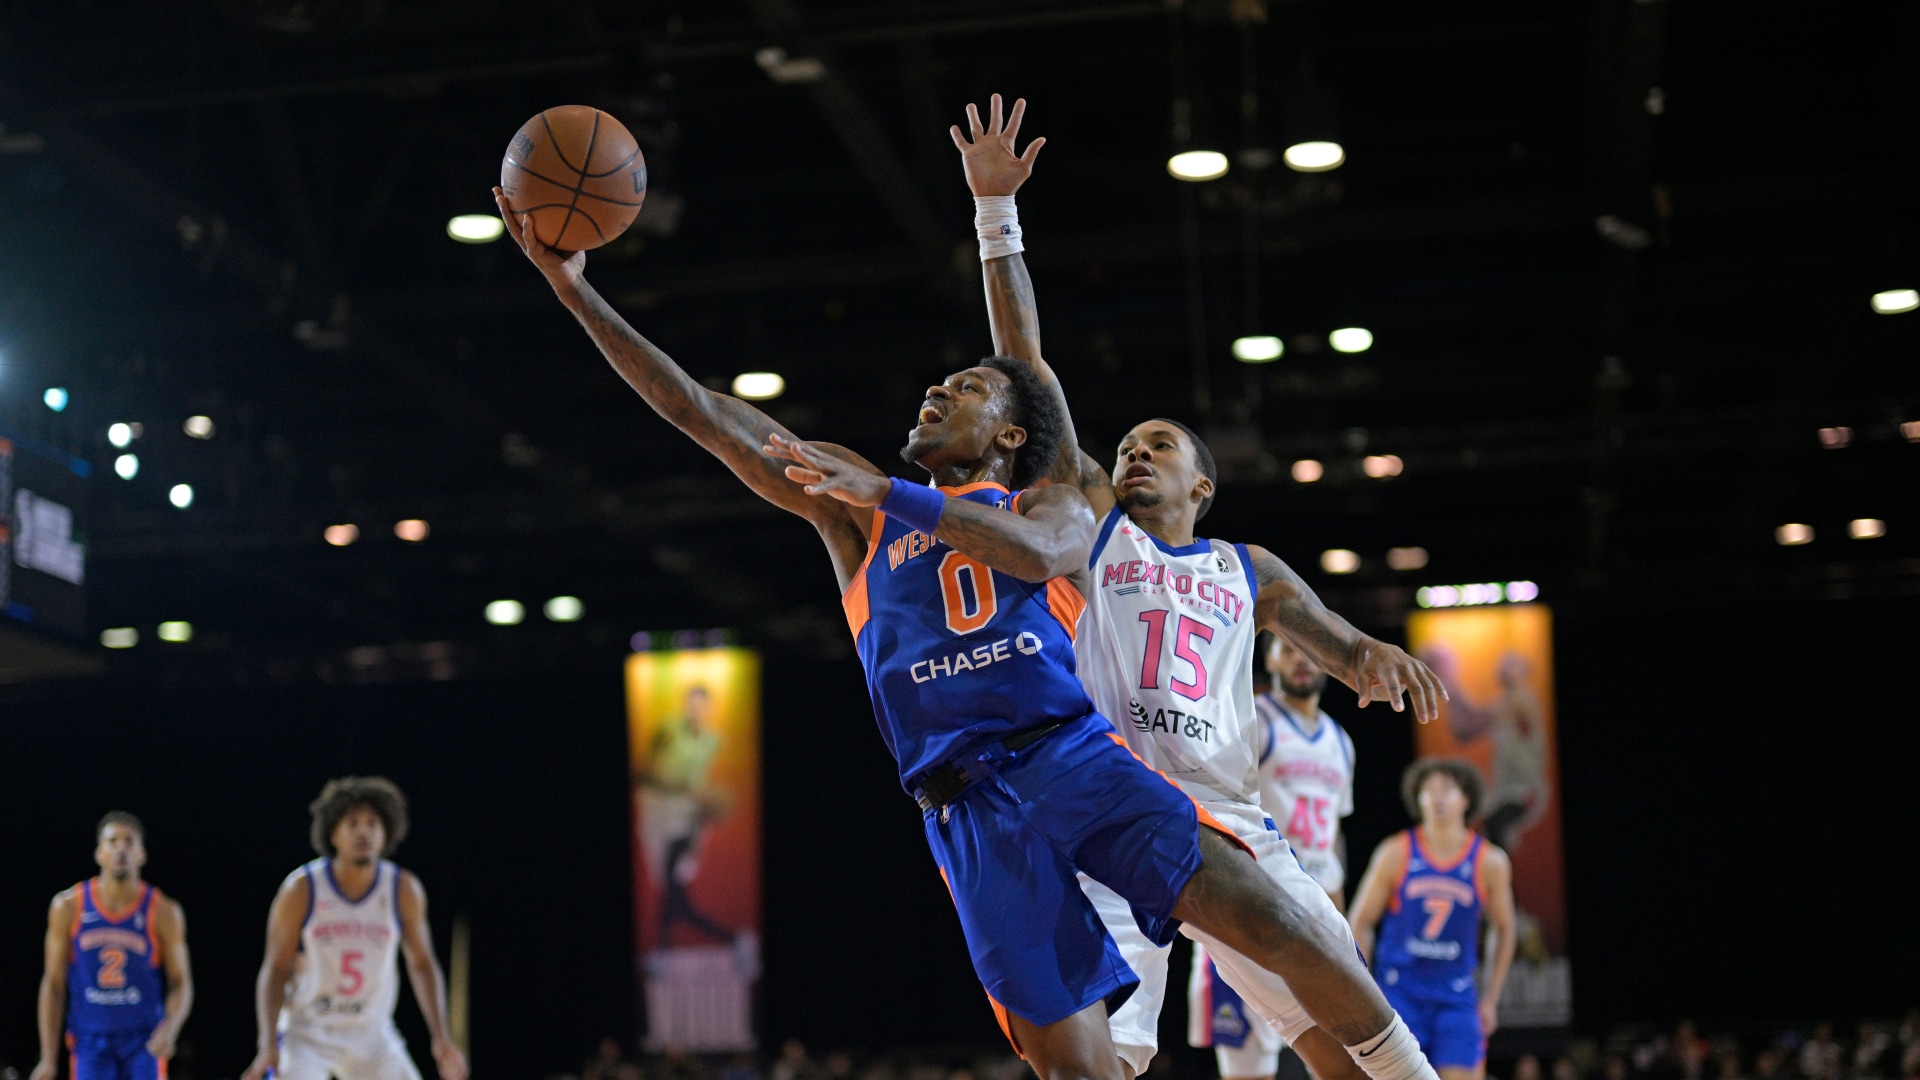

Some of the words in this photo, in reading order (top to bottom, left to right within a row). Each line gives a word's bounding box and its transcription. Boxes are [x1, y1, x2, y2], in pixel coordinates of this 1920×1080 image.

[938, 550, 997, 635] 0
[1102, 560, 1192, 595] MEXICO
[1198, 581, 1244, 623] CITY
[910, 638, 1012, 684] CHASE
[1138, 609, 1215, 702] 15
[1152, 708, 1214, 743] AT&T
[1286, 796, 1330, 850] 45
[1423, 897, 1454, 939] 7
[99, 948, 126, 987] 2
[339, 949, 365, 997] 5
